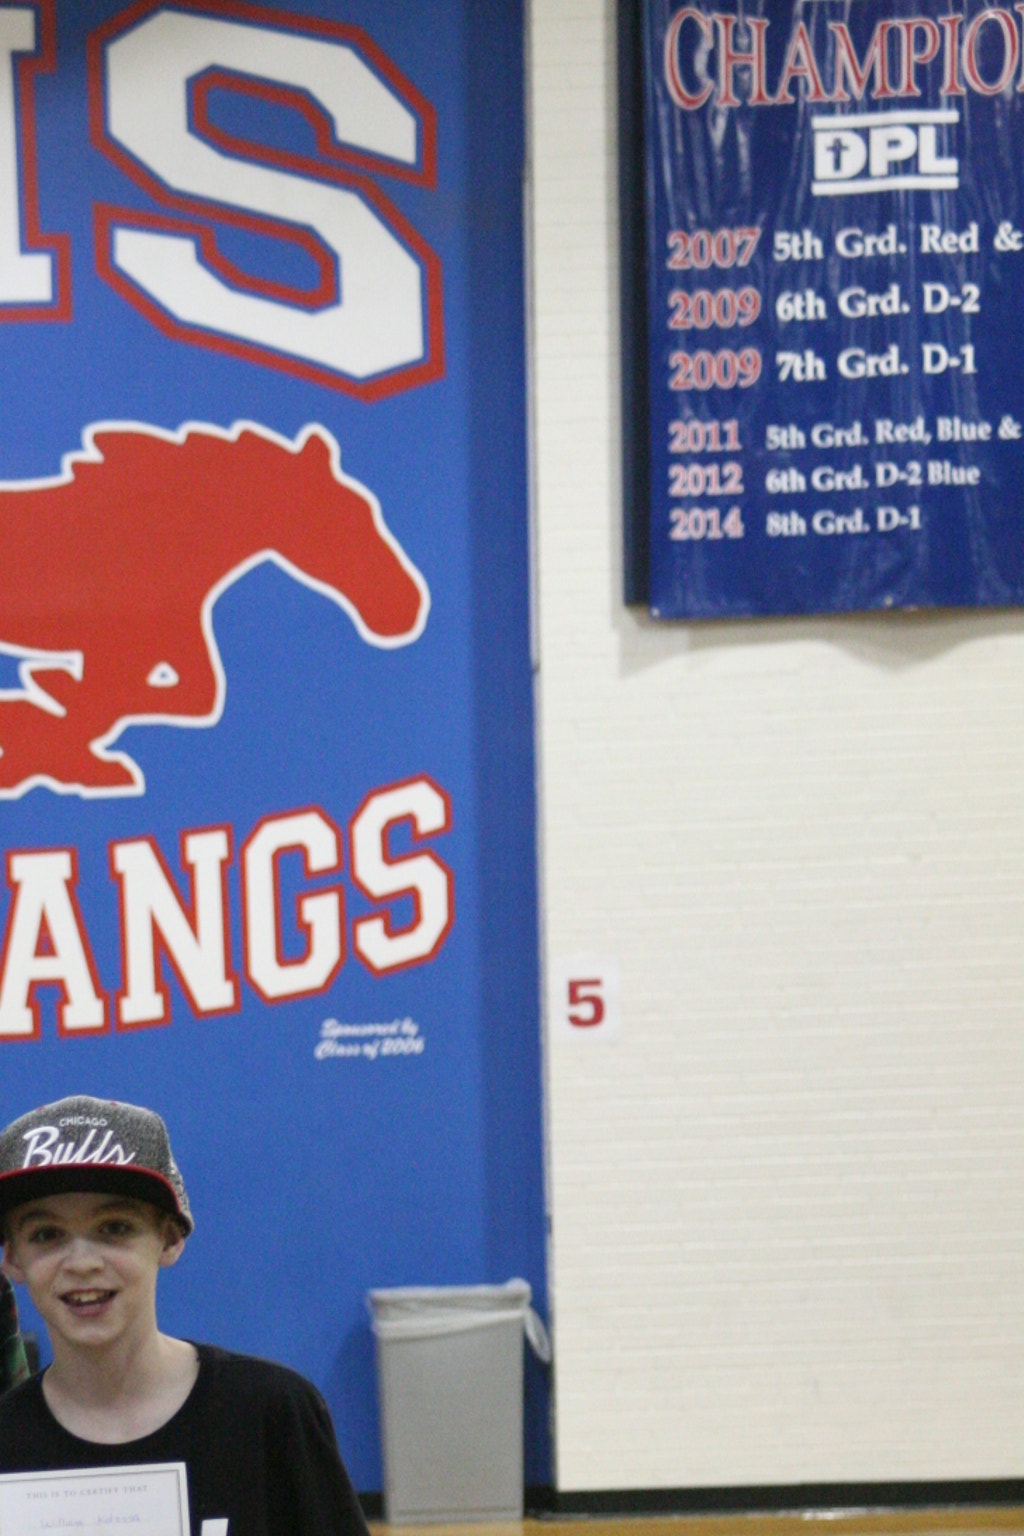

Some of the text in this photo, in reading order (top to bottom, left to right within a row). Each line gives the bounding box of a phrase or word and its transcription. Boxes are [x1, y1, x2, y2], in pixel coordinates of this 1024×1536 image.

[664, 3, 1024, 110] CHAMPIO
[814, 125, 959, 181] DPL
[666, 220, 1023, 270] 2007 5th Grd. Red &
[667, 282, 981, 330] 2009 6th Grd. D-2
[668, 343, 978, 391] 2009 7th Grd. D-1
[667, 413, 1023, 453] 2011 5th Grd. Red, Blue &
[667, 459, 982, 497] 2012 6th Grd. D-2 Blue
[668, 505, 922, 541] 2014 8th Grd. D-1
[567, 978, 605, 1028] 5
[59, 1116, 108, 1127] CHICAGO
[22, 1126, 136, 1169] Bulls
